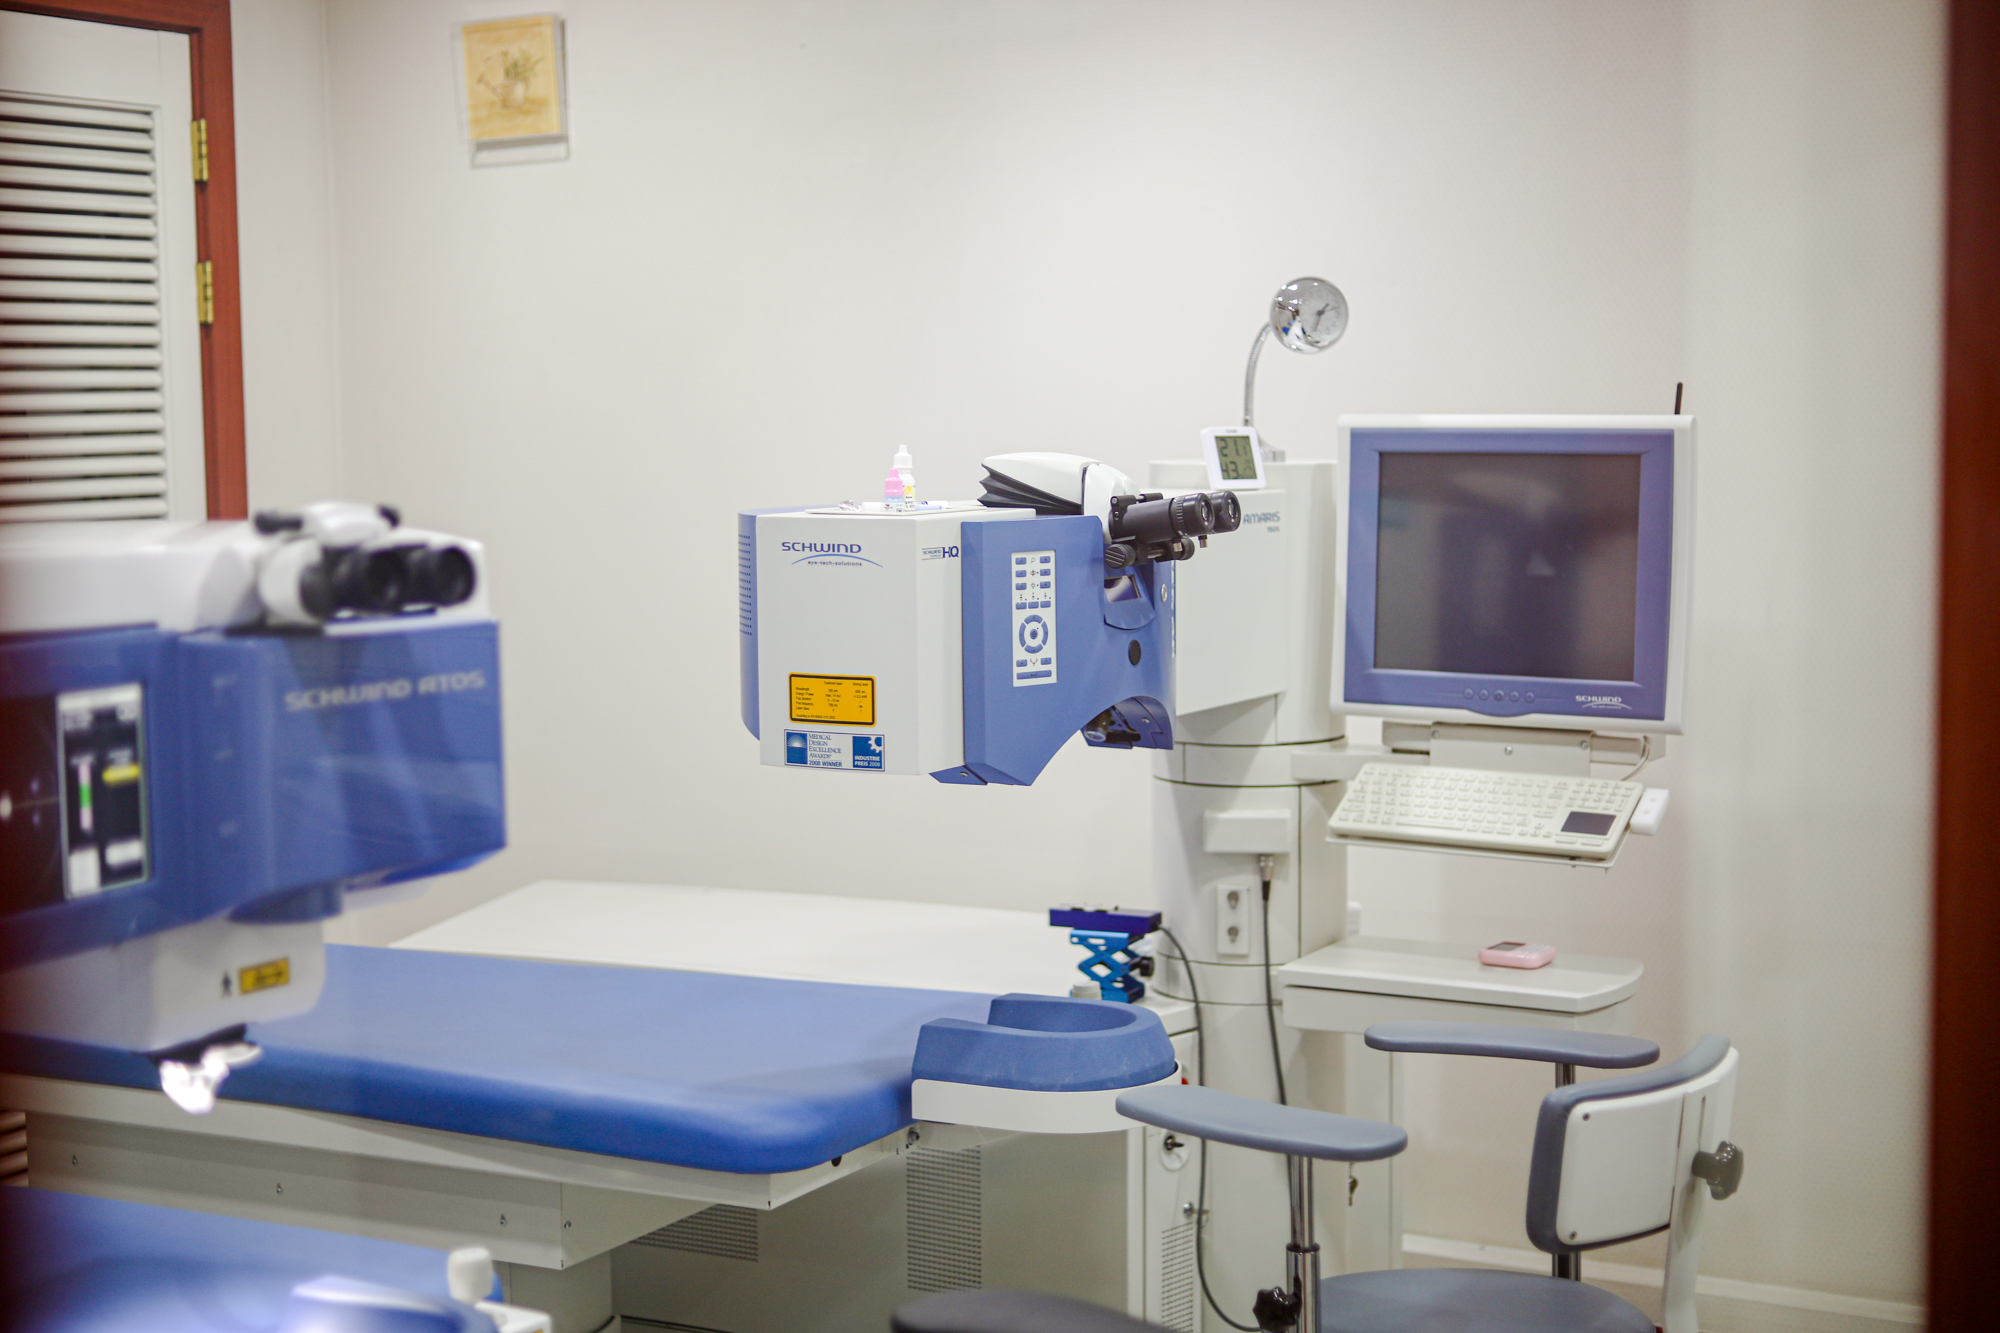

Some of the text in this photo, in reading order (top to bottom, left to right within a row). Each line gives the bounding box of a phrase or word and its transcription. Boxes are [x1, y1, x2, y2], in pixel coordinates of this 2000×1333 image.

[1243, 511, 1280, 524] AMARIS
[781, 541, 862, 554] SCHWIND
[942, 545, 960, 559] HQ
[807, 559, 863, 567] eye-tech-solutions
[284, 669, 486, 712] SCHWIND ATOS
[1575, 694, 1622, 703] SCHWIND
